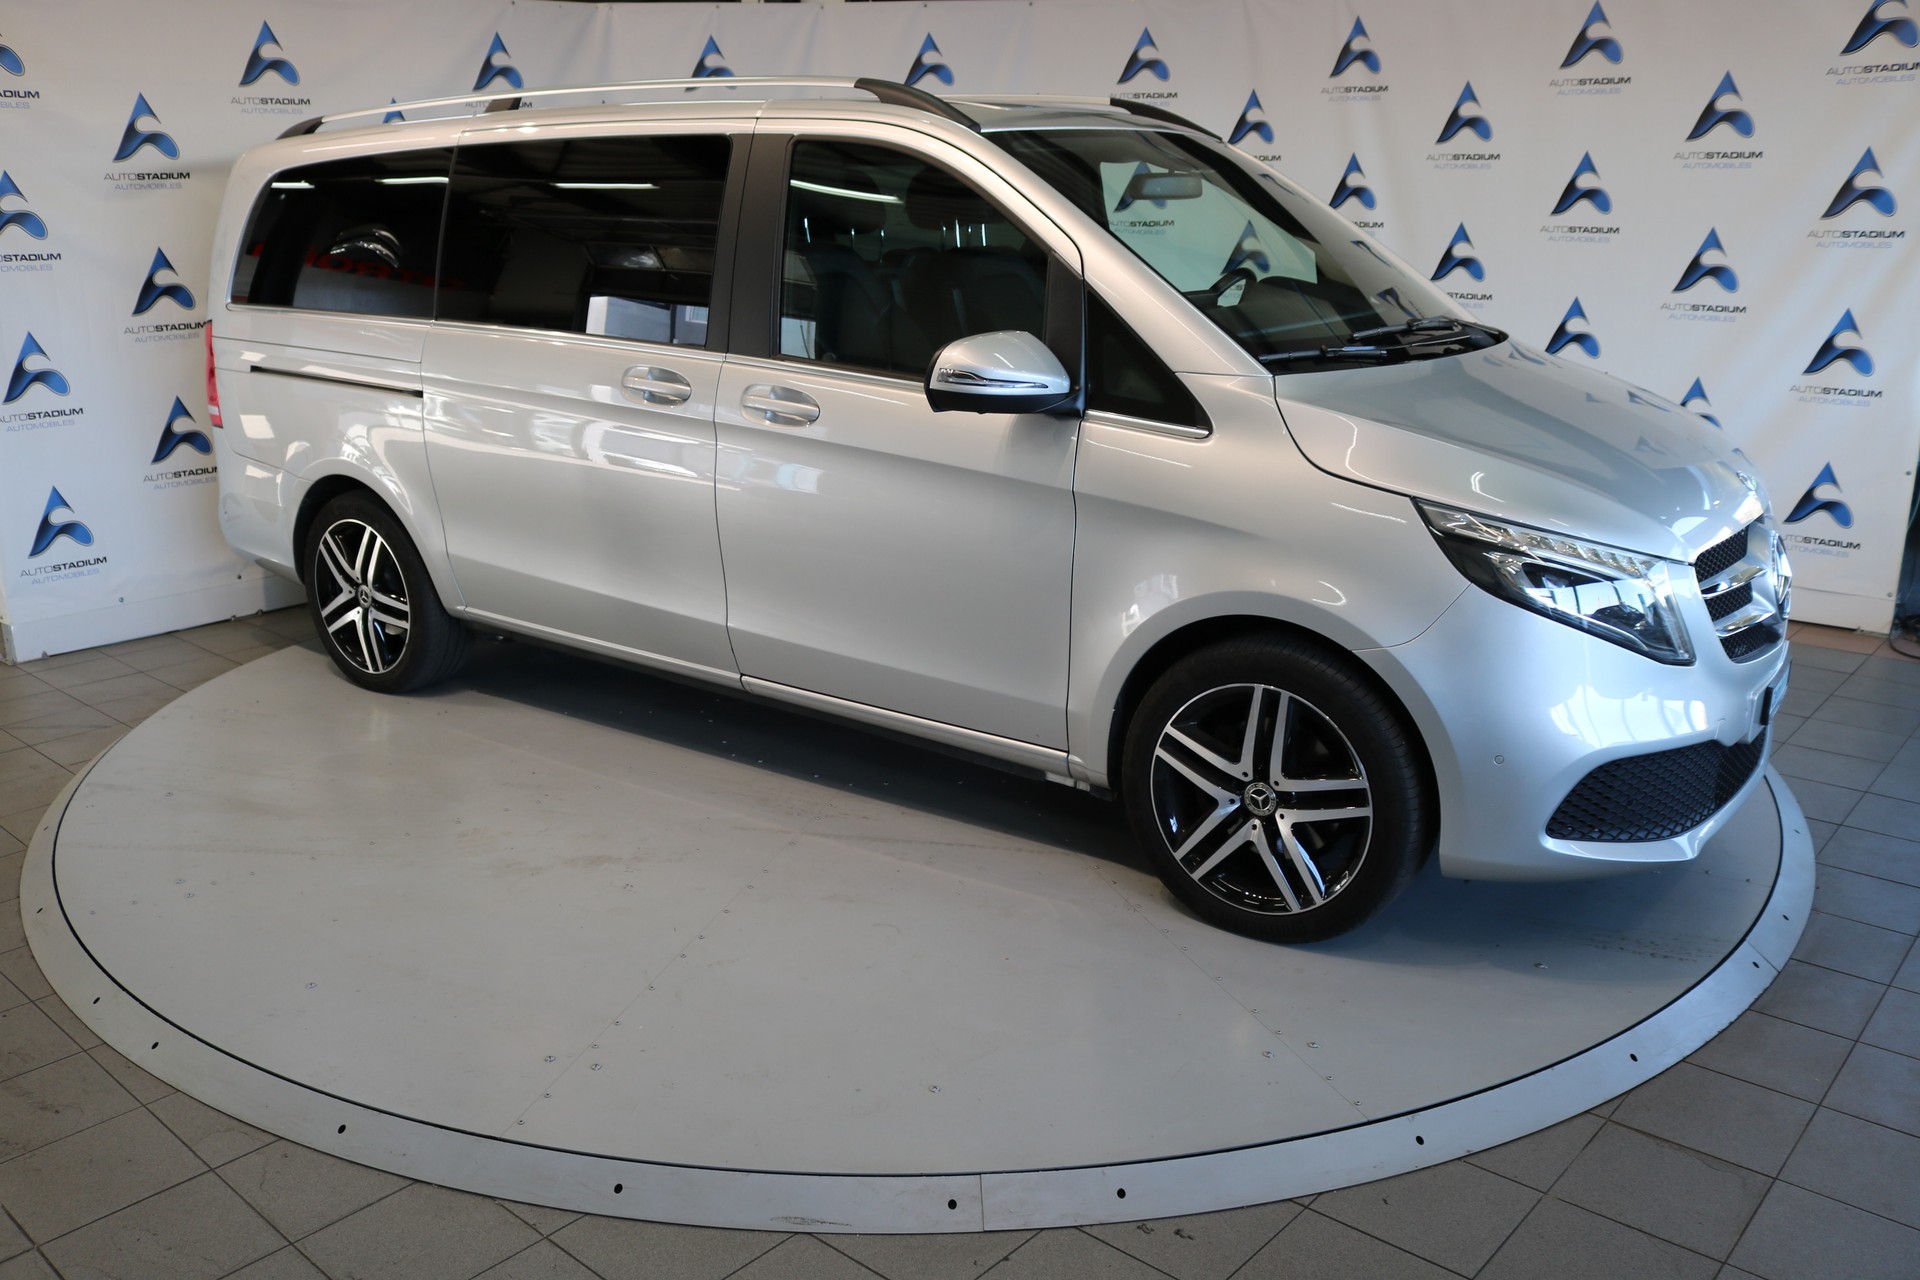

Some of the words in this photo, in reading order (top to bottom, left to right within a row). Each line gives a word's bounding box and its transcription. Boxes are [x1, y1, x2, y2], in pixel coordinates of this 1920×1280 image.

[1549, 76, 1632, 86] AUTOSTADIUM
[1836, 74, 1915, 86] AUTOMOBILES
[1321, 86, 1388, 94] AUTOSTADIUM
[1557, 87, 1621, 95] AUTOMOBILES
[231, 97, 310, 106] AUTOSTADIUM
[1426, 153, 1500, 161] AUTOSTADIUM
[1674, 151, 1763, 161] AUTOSTADIUM
[1682, 161, 1752, 170] AUTOMOBILES
[104, 172, 190, 181] AUTOSTADIUM
[114, 182, 182, 190] AUTOMOBILES
[1540, 225, 1620, 235] AUTOSTADIUM
[1808, 229, 1905, 240] AUTOSTADIUM
[1548, 235, 1610, 243] AUTOMOBILES
[1816, 240, 1892, 250] AUTOMOBILES
[0, 252, 61, 262] STADIUM
[1660, 302, 1746, 314] AUTOSTADIUM
[1668, 312, 1736, 322] AUTOMOBILES
[124, 322, 207, 335] AUTOSTADIUM
[134, 333, 199, 343] AUTOMOBILES
[1790, 384, 1882, 398] AUTOSTADIUM
[1798, 395, 1870, 407] AUTOMOBILES
[6, 420, 74, 432] AUTOMOBILES
[20, 556, 107, 578] AUTOSTADIUM
[32, 570, 100, 585] AUTOMOBILES
